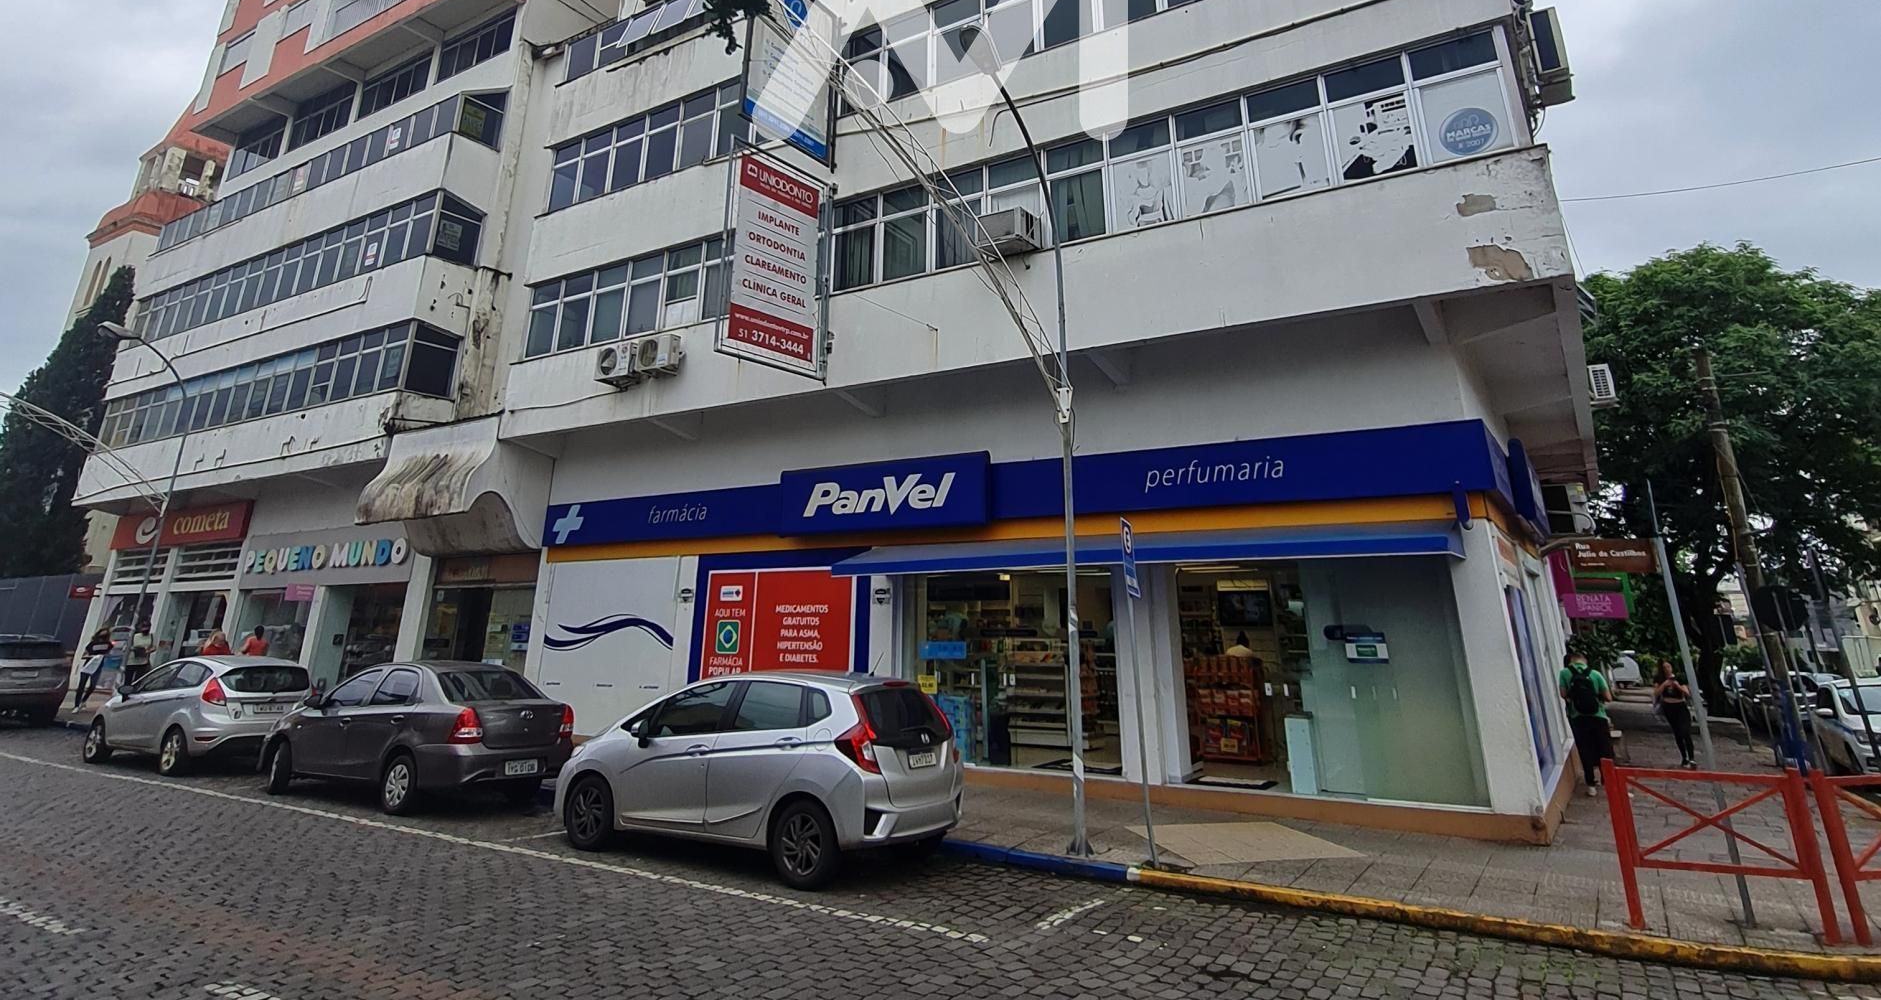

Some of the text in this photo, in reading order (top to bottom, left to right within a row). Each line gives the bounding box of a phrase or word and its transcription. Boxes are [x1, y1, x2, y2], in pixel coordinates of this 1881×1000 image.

[1446, 123, 1491, 140] MARCAS
[759, 169, 814, 203] UNIODONTO
[757, 210, 800, 236] IMPLANTE
[748, 231, 806, 261] ORTODONTIA
[744, 254, 807, 284] CLAREAMENTO
[742, 278, 806, 308] CLINICA GERAL
[738, 327, 804, 355] 51 3714-3444
[1144, 455, 1284, 494] perfumaria
[803, 472, 956, 517] PanVel
[173, 509, 230, 535] cometa
[648, 503, 707, 524] farmácia
[244, 537, 408, 575] PEQUENO MUNDO
[1575, 542, 1590, 550] Rua
[1609, 549, 1647, 557] Castilhos
[714, 608, 746, 618] AQUI TEM
[775, 604, 829, 613] MEDICAMENTOS
[782, 617, 820, 626] GRATUITOS
[780, 629, 820, 639] PARA ASMA,
[776, 640, 823, 651] HIPERTENSÃO
[709, 655, 743, 666] FARMÁCIA
[779, 653, 819, 663] E DIABETES.
